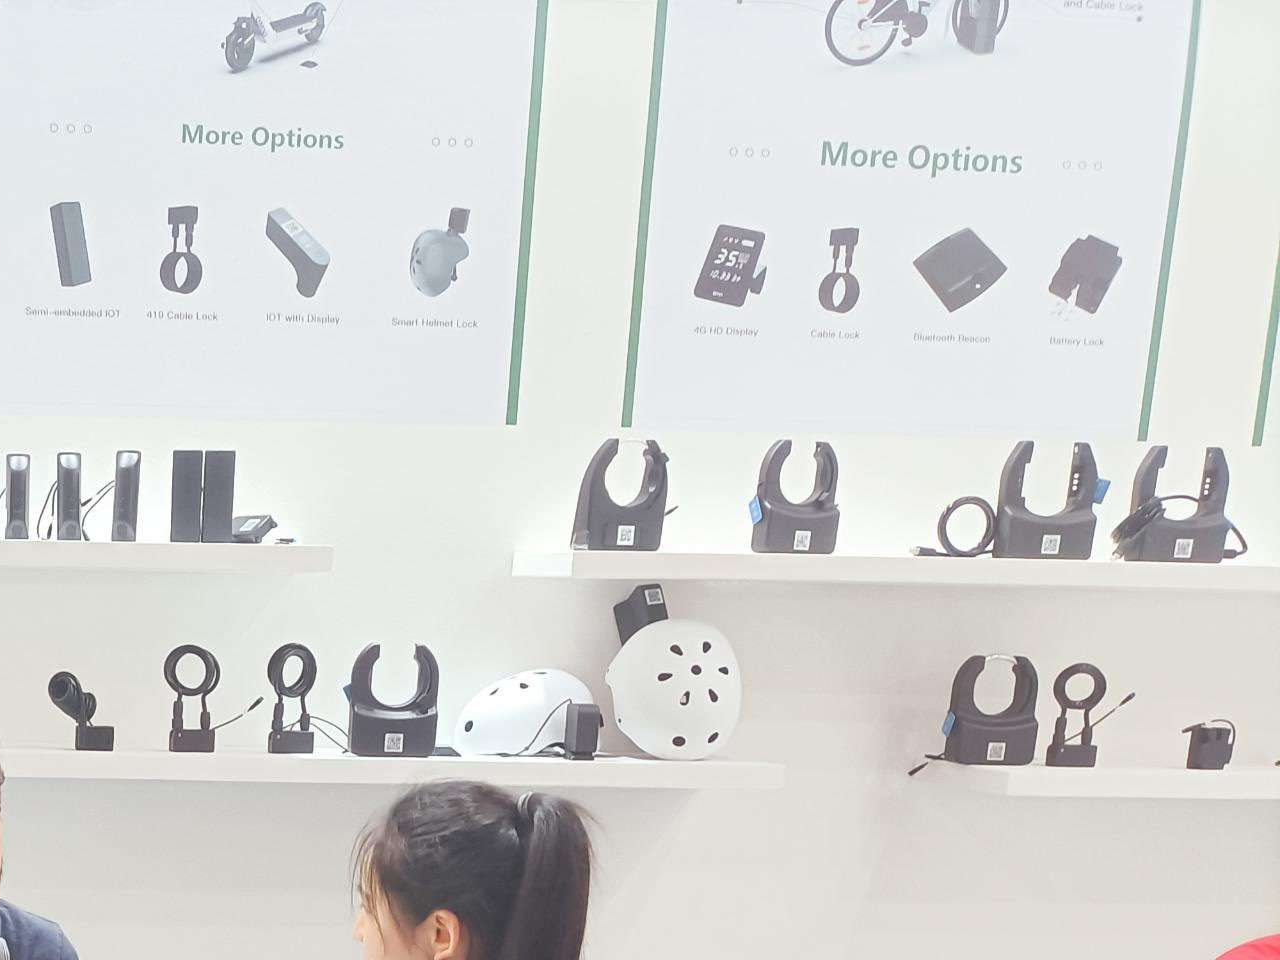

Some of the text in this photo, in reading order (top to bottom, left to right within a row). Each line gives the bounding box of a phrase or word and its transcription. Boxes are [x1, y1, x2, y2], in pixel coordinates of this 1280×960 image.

[181, 123, 345, 153] More Options
[820, 141, 1024, 178] More Options
[24, 306, 121, 318] Semi-embedded IOT
[166, 310, 193, 320] Cable
[195, 311, 219, 321] Lock
[265, 312, 341, 325] IOT with Display
[391, 317, 479, 329] Smart Helmet Lock
[693, 326, 759, 337] 4G HD Display
[810, 329, 861, 340] Cable Lock
[913, 332, 991, 344] Bluetooth Beacon
[1049, 335, 1105, 346] Battery Lock
